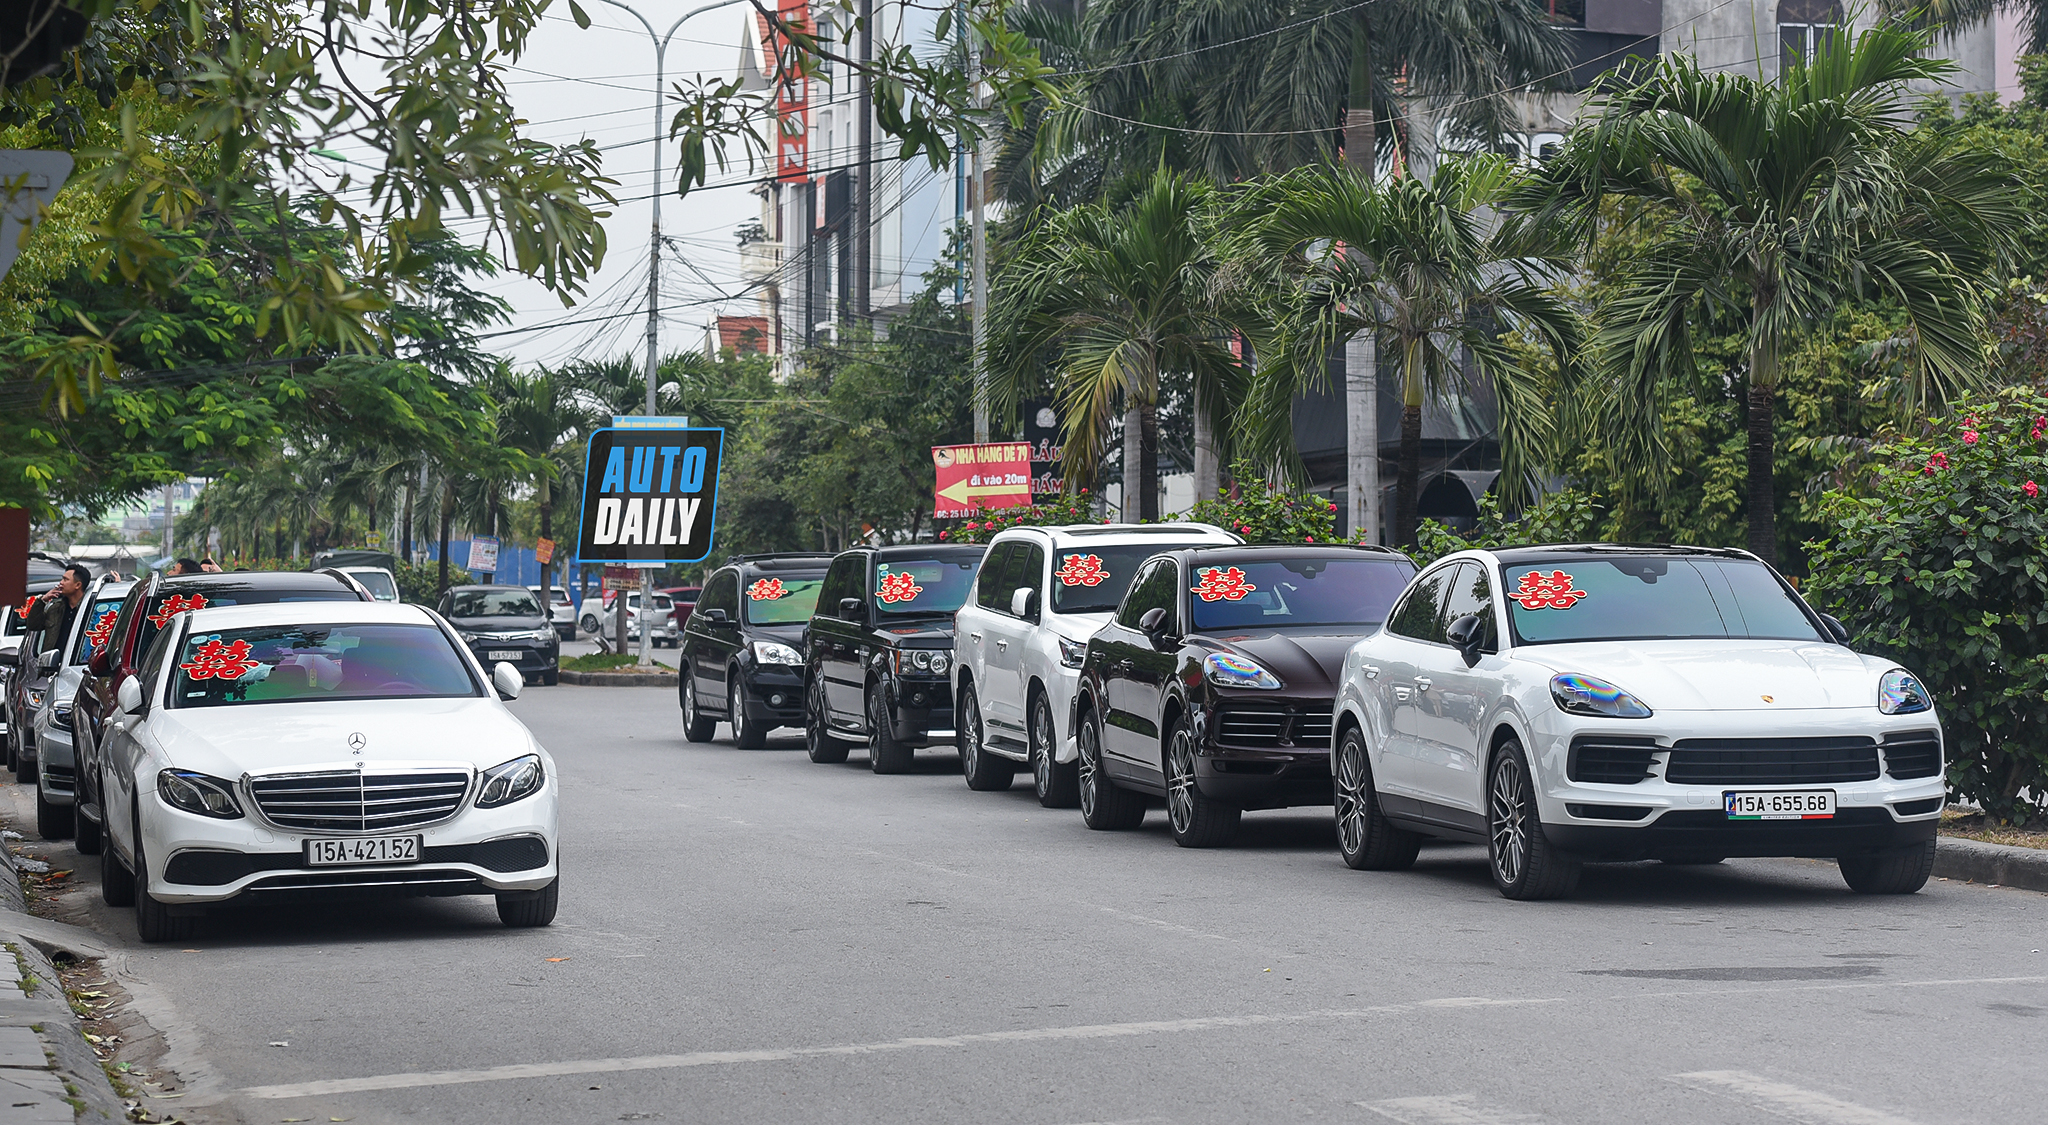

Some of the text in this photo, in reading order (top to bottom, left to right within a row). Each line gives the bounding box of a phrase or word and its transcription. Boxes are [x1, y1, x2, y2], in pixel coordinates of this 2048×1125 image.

[1017, 445, 1028, 462] 79
[970, 474, 981, 486] đi
[1004, 473, 1027, 485] 20m
[950, 509, 959, 518] 25
[1736, 794, 1828, 812] 15A-655.68
[314, 838, 415, 862] 15A-421.52
